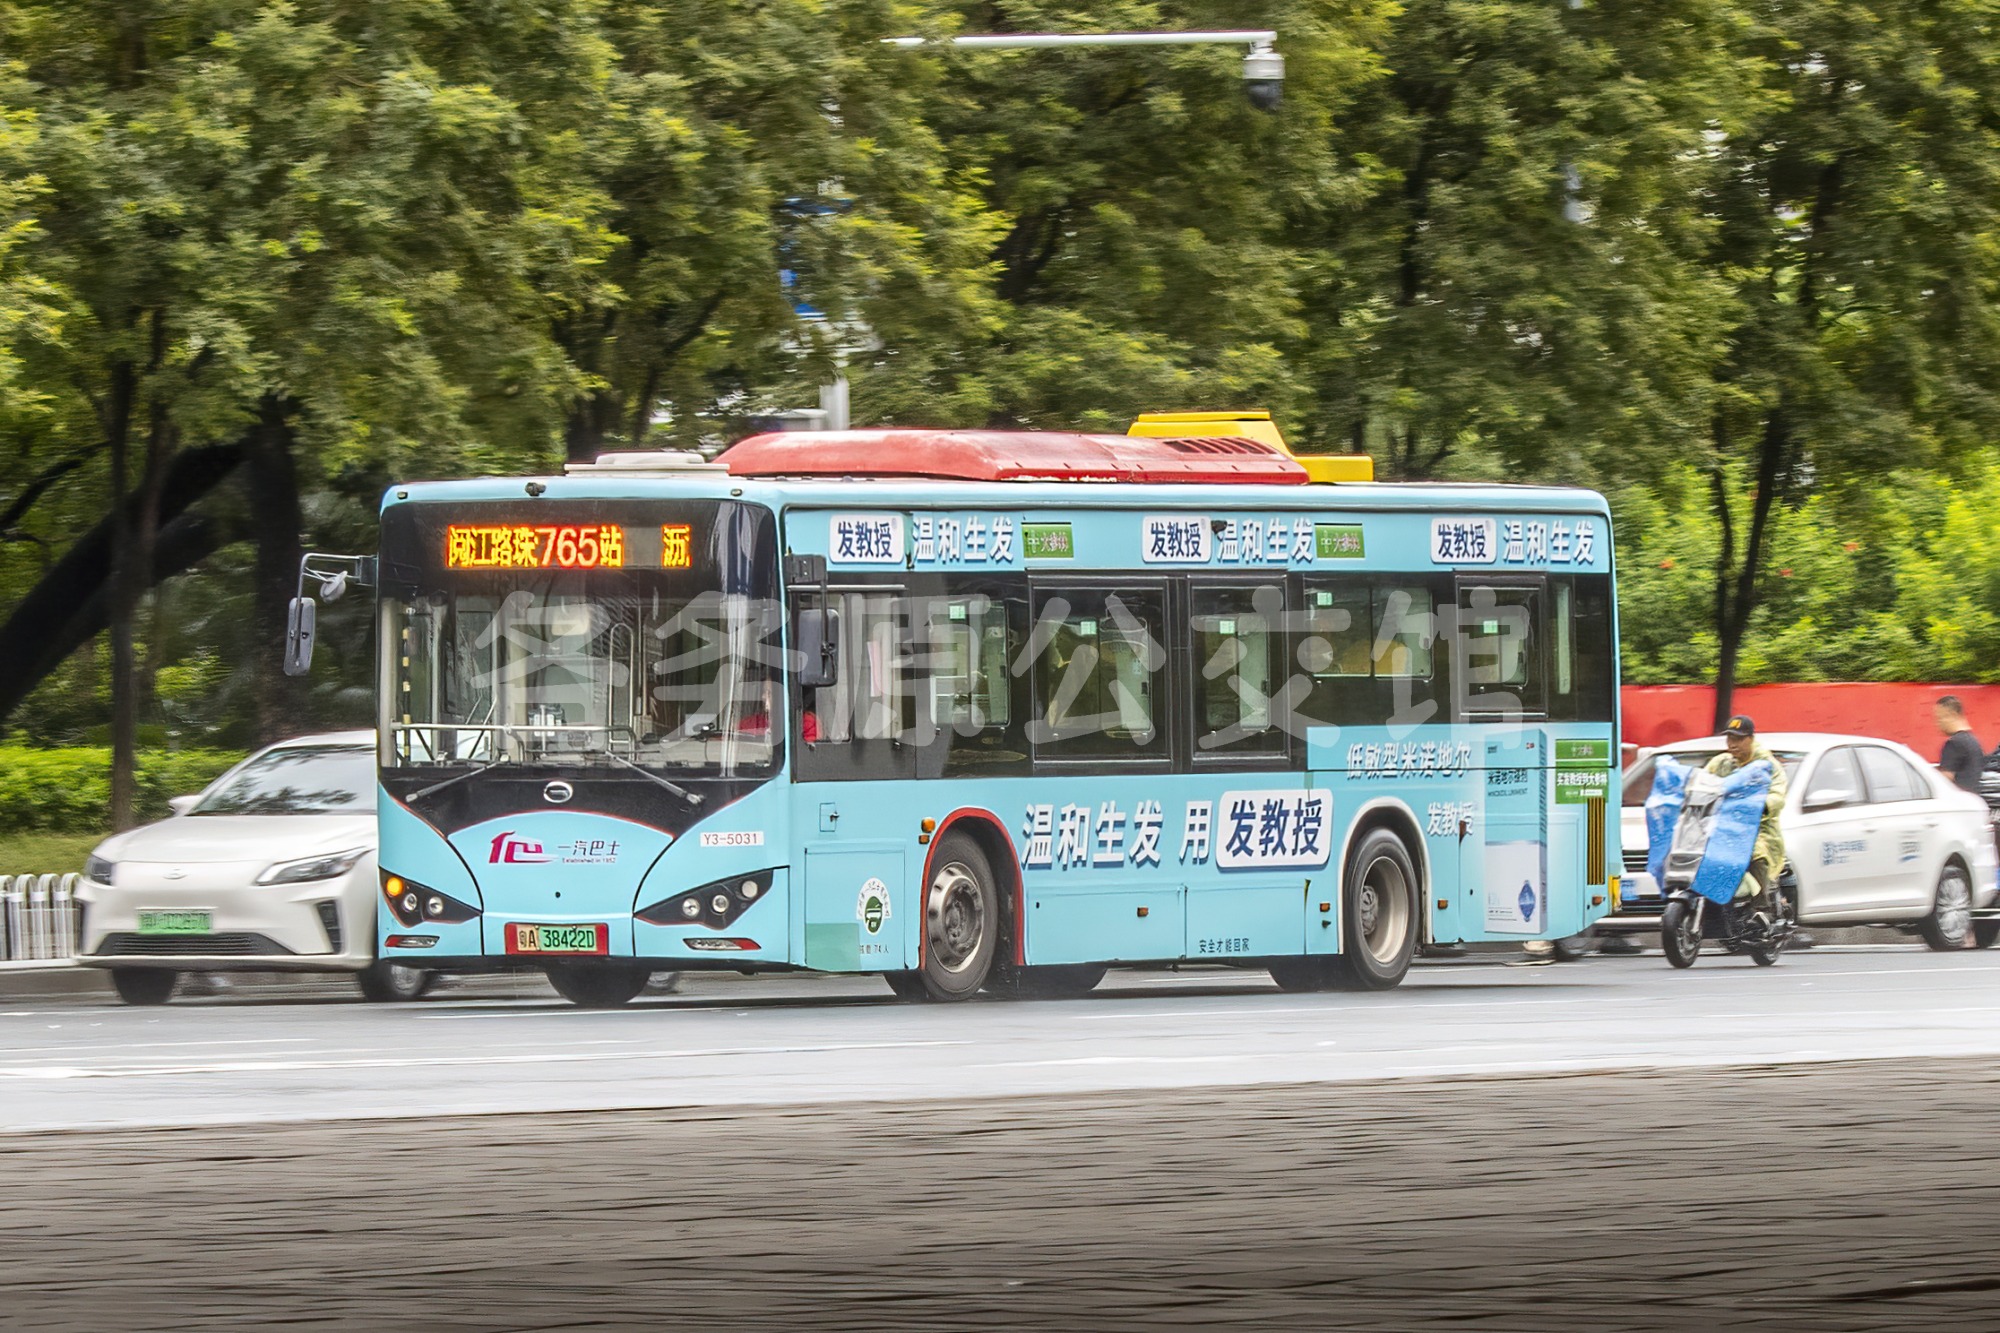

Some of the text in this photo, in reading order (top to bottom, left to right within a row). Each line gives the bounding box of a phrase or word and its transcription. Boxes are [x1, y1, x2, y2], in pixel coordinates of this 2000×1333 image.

[837, 515, 1014, 565] 发教授 温和生发
[1151, 517, 1314, 565] 发教授 温和生发
[1438, 519, 1595, 566] 发教授 温和生发
[703, 833, 758, 845] Y3-5031
[1020, 797, 1323, 871] 温和生发 用 发教授
[1427, 801, 1474, 837] 发教授
[558, 840, 620, 857] 一汽巴士
